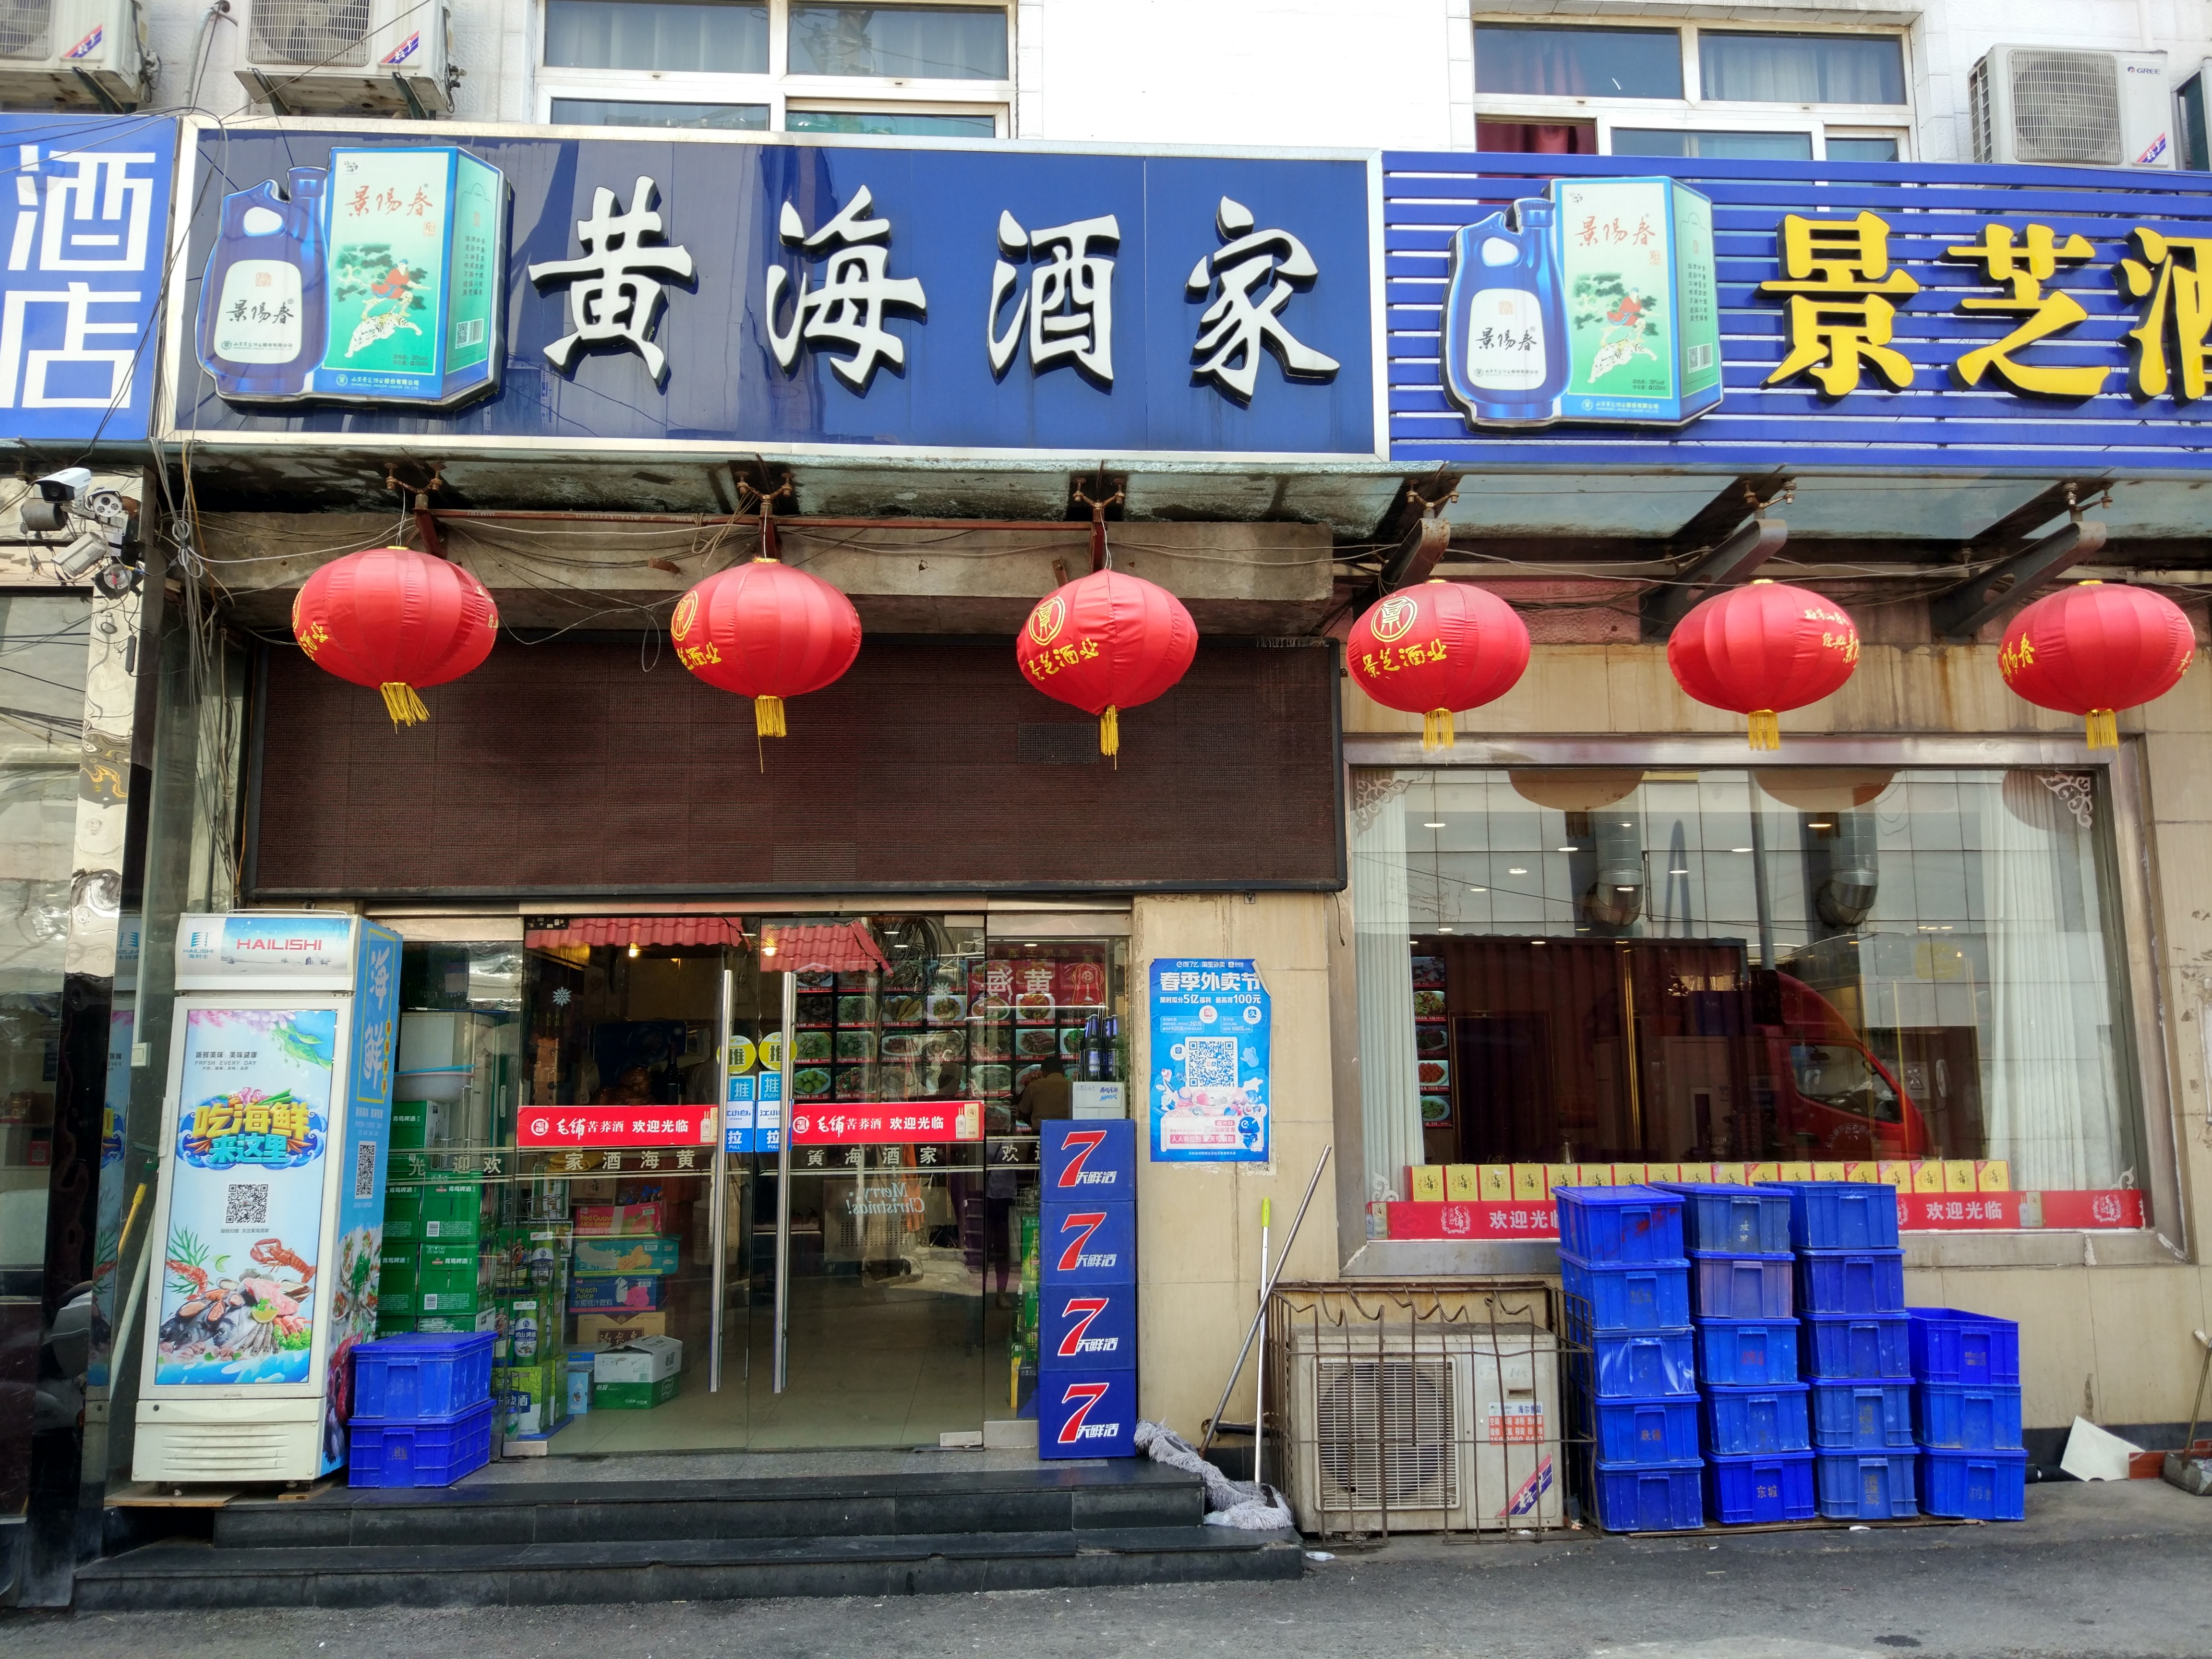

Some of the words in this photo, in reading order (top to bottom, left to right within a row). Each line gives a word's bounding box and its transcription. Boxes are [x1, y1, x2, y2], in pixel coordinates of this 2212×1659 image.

[0, 145, 156, 408] 酒店
[529, 175, 1341, 407] 黄海酒家
[237, 938, 322, 950] HAILISHI
[1160, 972, 1261, 991] 春季外卖节
[1160, 994, 1211, 1004] 限时瓜分5亿福利
[1215, 994, 1261, 1004] 最高得100元
[734, 1082, 749, 1097] 推
[764, 1077, 779, 1093] 推
[191, 1102, 310, 1141] 吃海鲜
[632, 1119, 689, 1133] 欢迎光临
[890, 1117, 944, 1130] 欢迎光临
[728, 1130, 742, 1144] 拉
[767, 1130, 780, 1144] 拉
[209, 1133, 289, 1164] 来这里
[807, 1146, 937, 1166] 黄海酒家
[1926, 1201, 2003, 1220] 欢迎光临
[1518, 1405, 1541, 1414] 海尔售后
[1490, 1417, 1500, 1426] 空调
[1515, 1417, 1525, 1426] 冰柜
[1490, 1427, 1500, 1436] 维修
